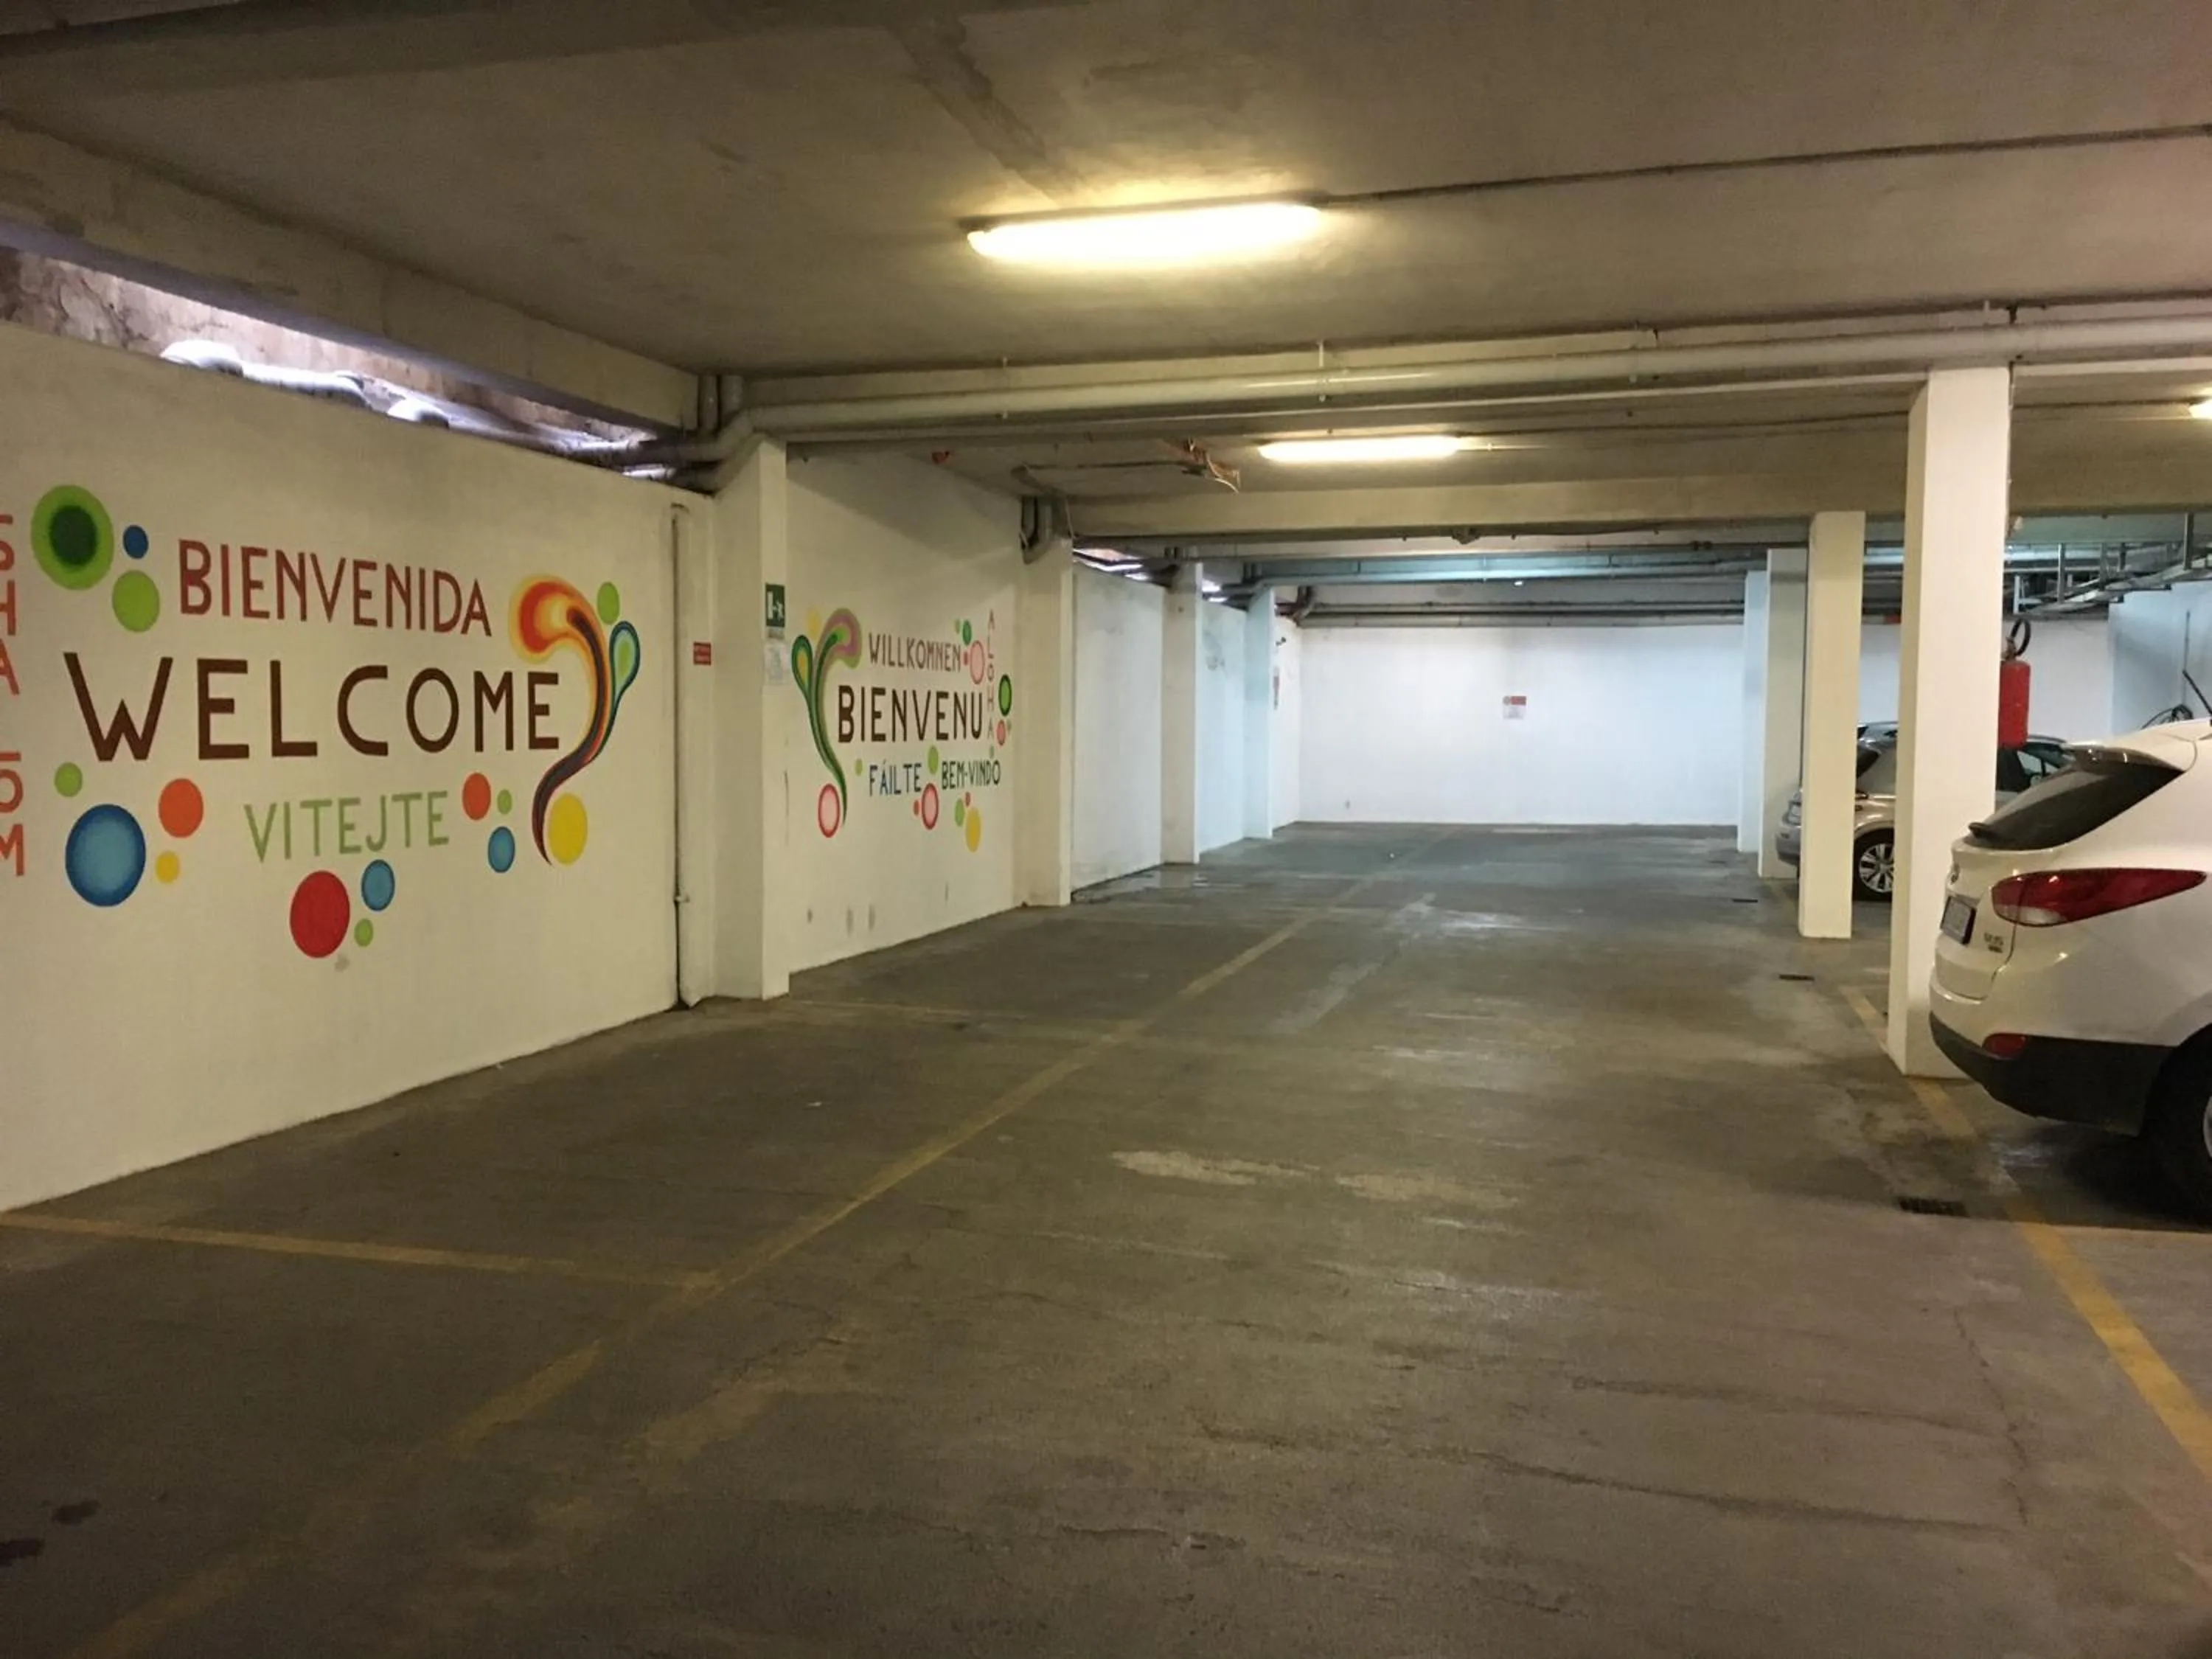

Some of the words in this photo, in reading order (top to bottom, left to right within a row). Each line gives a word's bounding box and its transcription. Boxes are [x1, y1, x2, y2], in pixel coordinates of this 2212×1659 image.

[178, 539, 492, 636] BIENVENIDA
[63, 653, 560, 762] WELCOME
[838, 684, 983, 743] BIENVENU
[869, 759, 922, 796] FÁILTE
[942, 760, 1001, 790] BEM-VINDO
[244, 790, 449, 863] VITEJTE
